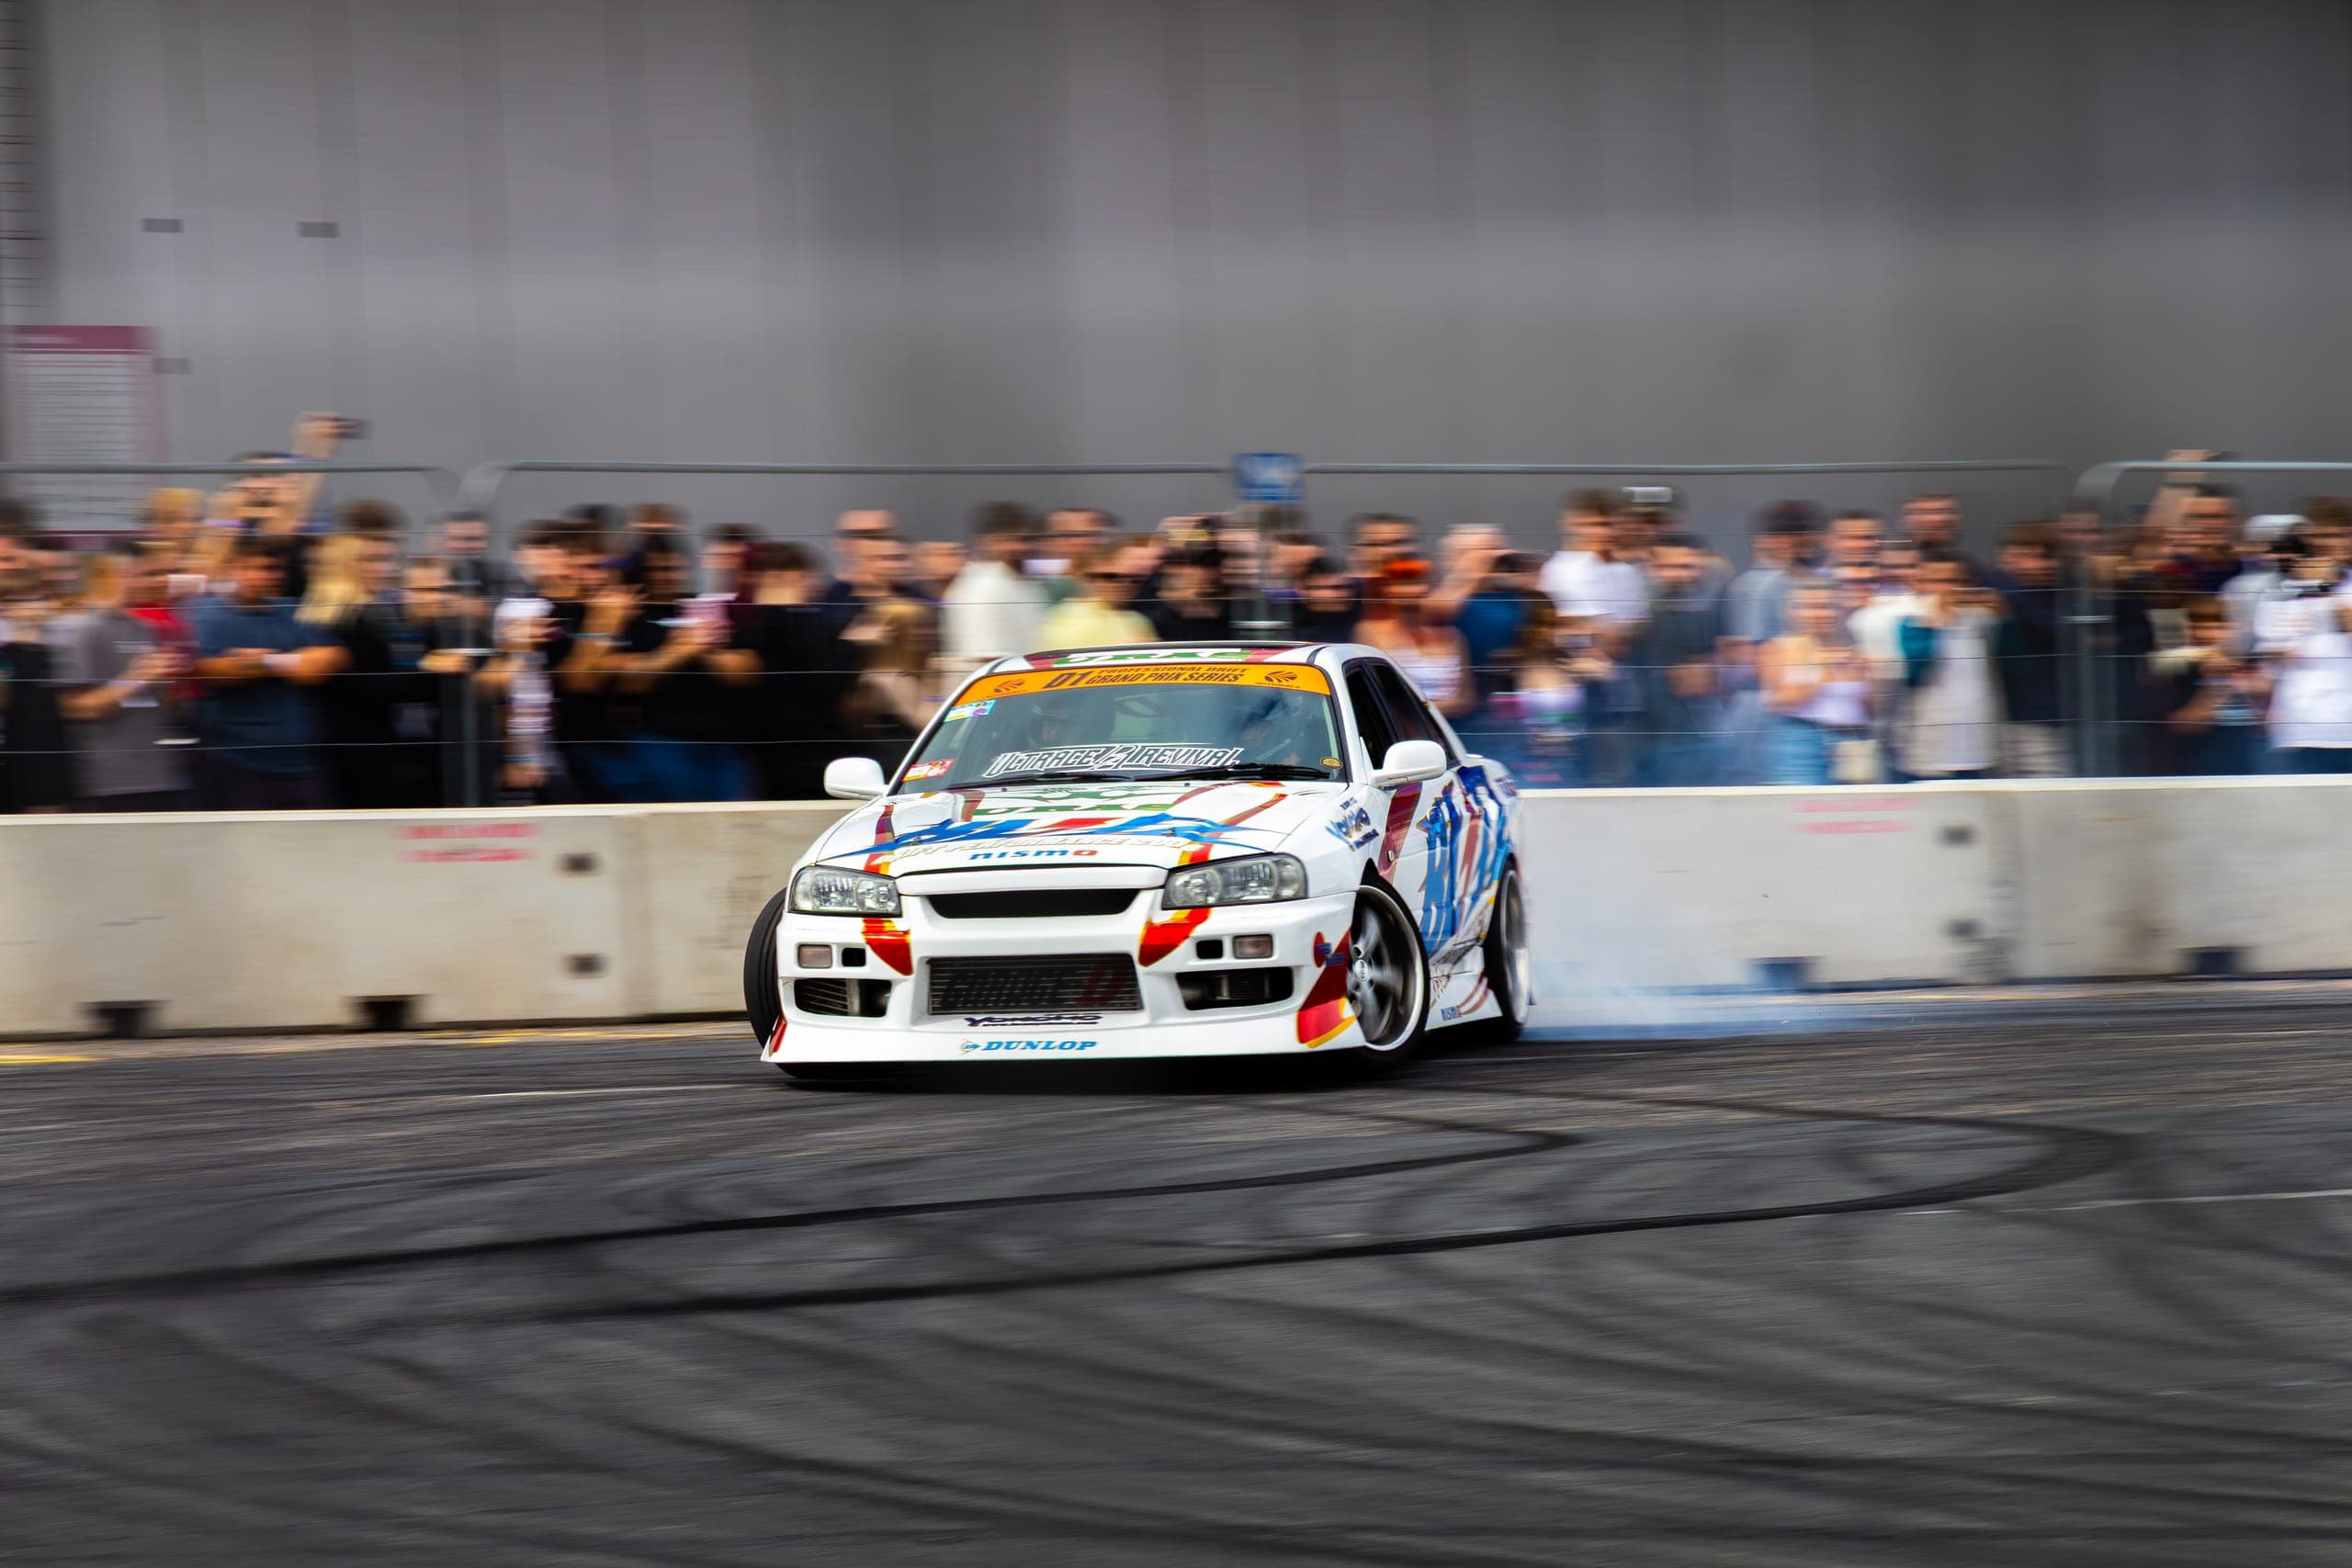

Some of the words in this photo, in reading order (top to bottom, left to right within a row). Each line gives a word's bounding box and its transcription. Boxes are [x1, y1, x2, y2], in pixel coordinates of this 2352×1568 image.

[1098, 666, 1203, 674] PROFESSIONAL
[1043, 671, 1094, 689] D1
[1086, 672, 1144, 685] GRAND
[1144, 671, 1186, 682] PRIX
[1183, 671, 1244, 682] SERIES
[981, 748, 1108, 778] ULTRACE
[1127, 746, 1245, 767] REVIVAL
[968, 849, 1099, 861] nismo
[982, 1040, 1098, 1051] DUNLOP
